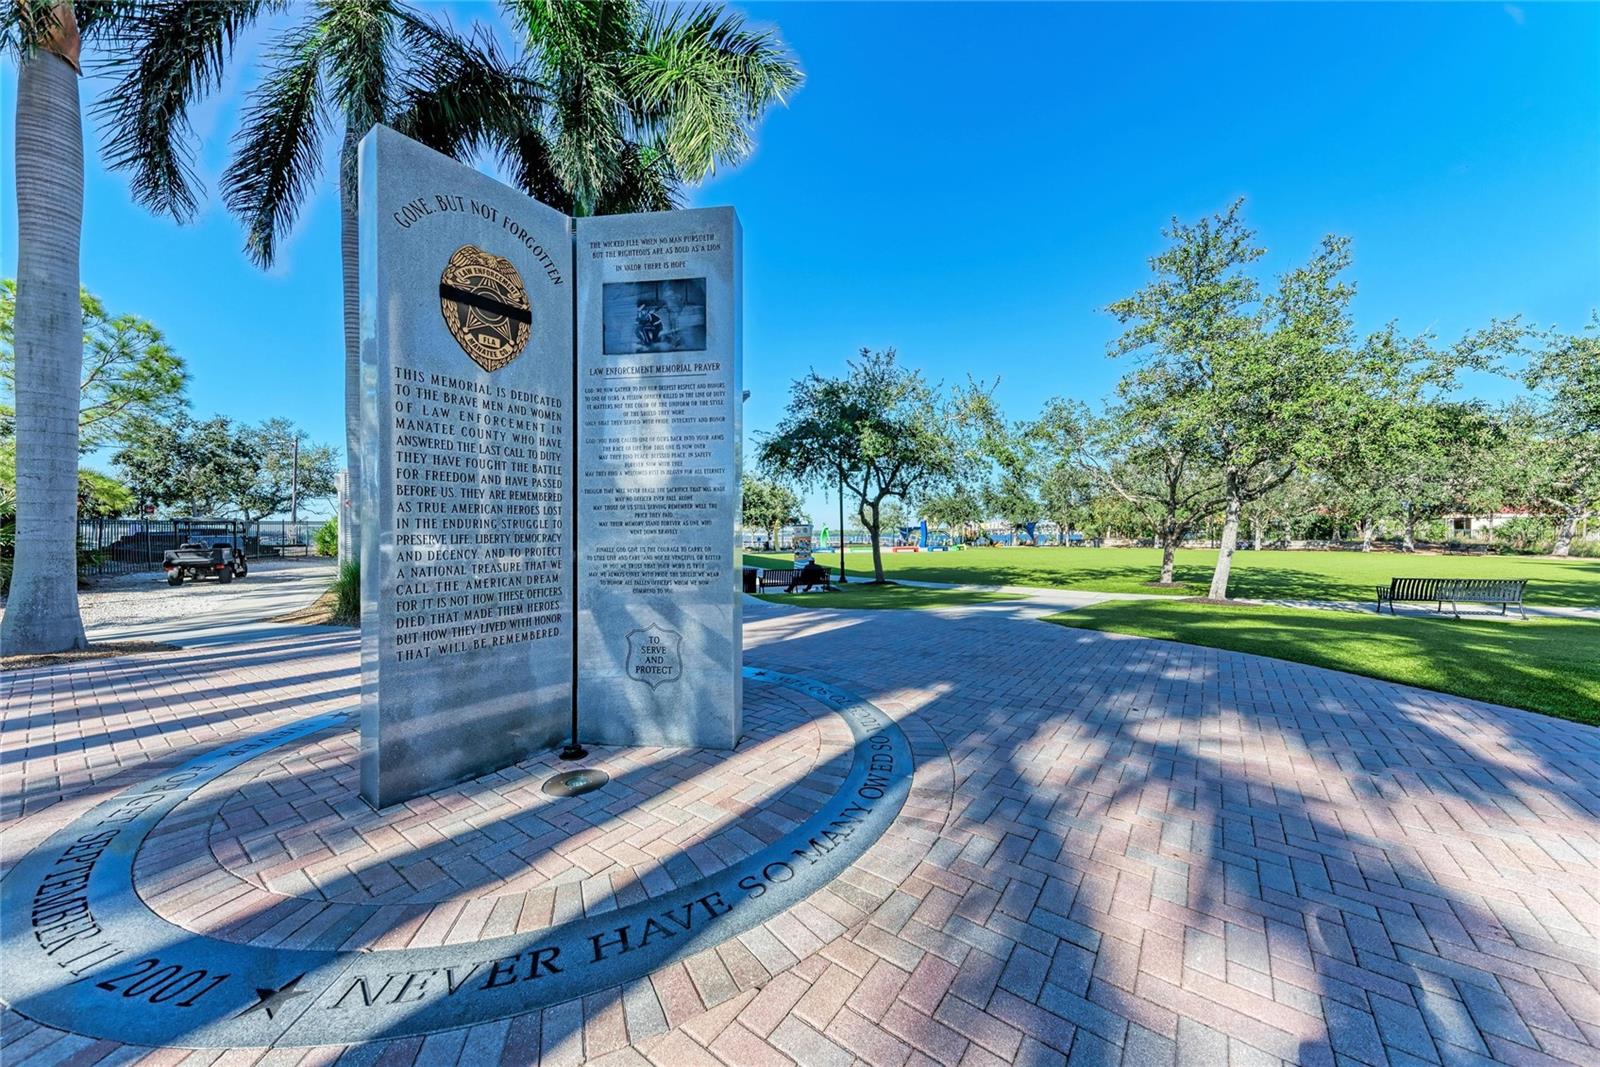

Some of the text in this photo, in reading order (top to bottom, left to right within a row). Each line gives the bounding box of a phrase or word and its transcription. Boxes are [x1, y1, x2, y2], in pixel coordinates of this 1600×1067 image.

[435, 195, 464, 212] BUT
[471, 200, 499, 223] NOT
[503, 216, 564, 286] FORGOTTEN
[593, 251, 603, 259] BUT
[618, 248, 650, 257] RIGHTEOUS
[653, 247, 664, 255] ARE
[675, 246, 689, 254] BOLD
[692, 245, 699, 253] AS
[707, 244, 720, 252] LION
[459, 267, 519, 295] LAW ENFORCEMENT
[468, 338, 511, 357] MANATEE CO.
[483, 337, 497, 346] FLA
[590, 363, 720, 376] LAW ENFORCEMENT MEMORIAL PRAYER
[395, 367, 562, 408] THIS MEMORIAL IS DEDICATED
[395, 384, 562, 421] TO THE BRAVE MEN AND WOMEN
[396, 401, 562, 435] OF LAW ENFORCEMENT IN
[396, 418, 562, 448] MANATEE COUNTY WHO HAVE
[396, 435, 561, 461] ANSWERED THE LAST CALL TO DUTY
[396, 452, 562, 475] THEY HAVE FOUGHT THE BATTLE
[396, 468, 562, 489] FOR FREEDOM AND HAVE PASSED
[396, 485, 437, 497] BEFORE
[461, 488, 485, 499] THEY
[489, 490, 506, 500] ARE
[510, 491, 562, 502] REMEMBERED
[397, 502, 562, 515] AS TRUE AMERICAN HEROES LOST
[397, 519, 562, 529] IN THE ENDURING STRUGGLE TO
[397, 534, 446, 545] PRESERVE
[515, 533, 562, 543] DEMOCRACY
[397, 550, 422, 562] AND
[485, 548, 508, 559] AND
[510, 548, 521, 558] TO
[525, 547, 562, 557] PROTECT
[397, 560, 562, 578] A NATIONAL TREASURE THAT WE
[396, 583, 429, 595] CALL
[436, 581, 459, 593] THE
[466, 577, 522, 590] AMERICAN
[397, 587, 562, 612] FOR IT IS NOT HOW THESE OFFICERS
[397, 601, 559, 629] DIED THAT MADE THEM HEROES
[397, 614, 562, 646] BUT HOW THEY LIVED WITH HONOR
[648, 636, 660, 644] TO
[397, 646, 431, 662] THAT
[439, 641, 467, 655] WILL
[474, 638, 489, 650] BE
[641, 646, 666, 654] SERVE
[645, 656, 664, 664] AND
[635, 666, 673, 674] PROTECT
[868, 735, 893, 752] SO
[858, 753, 893, 800] OWED
[791, 801, 873, 865] MANY
[738, 861, 794, 900] SO
[32, 829, 121, 956] SEPTEMBER
[97, 959, 231, 1007] 2001
[587, 891, 733, 964] HAVE
[327, 946, 563, 1009] NEVER
